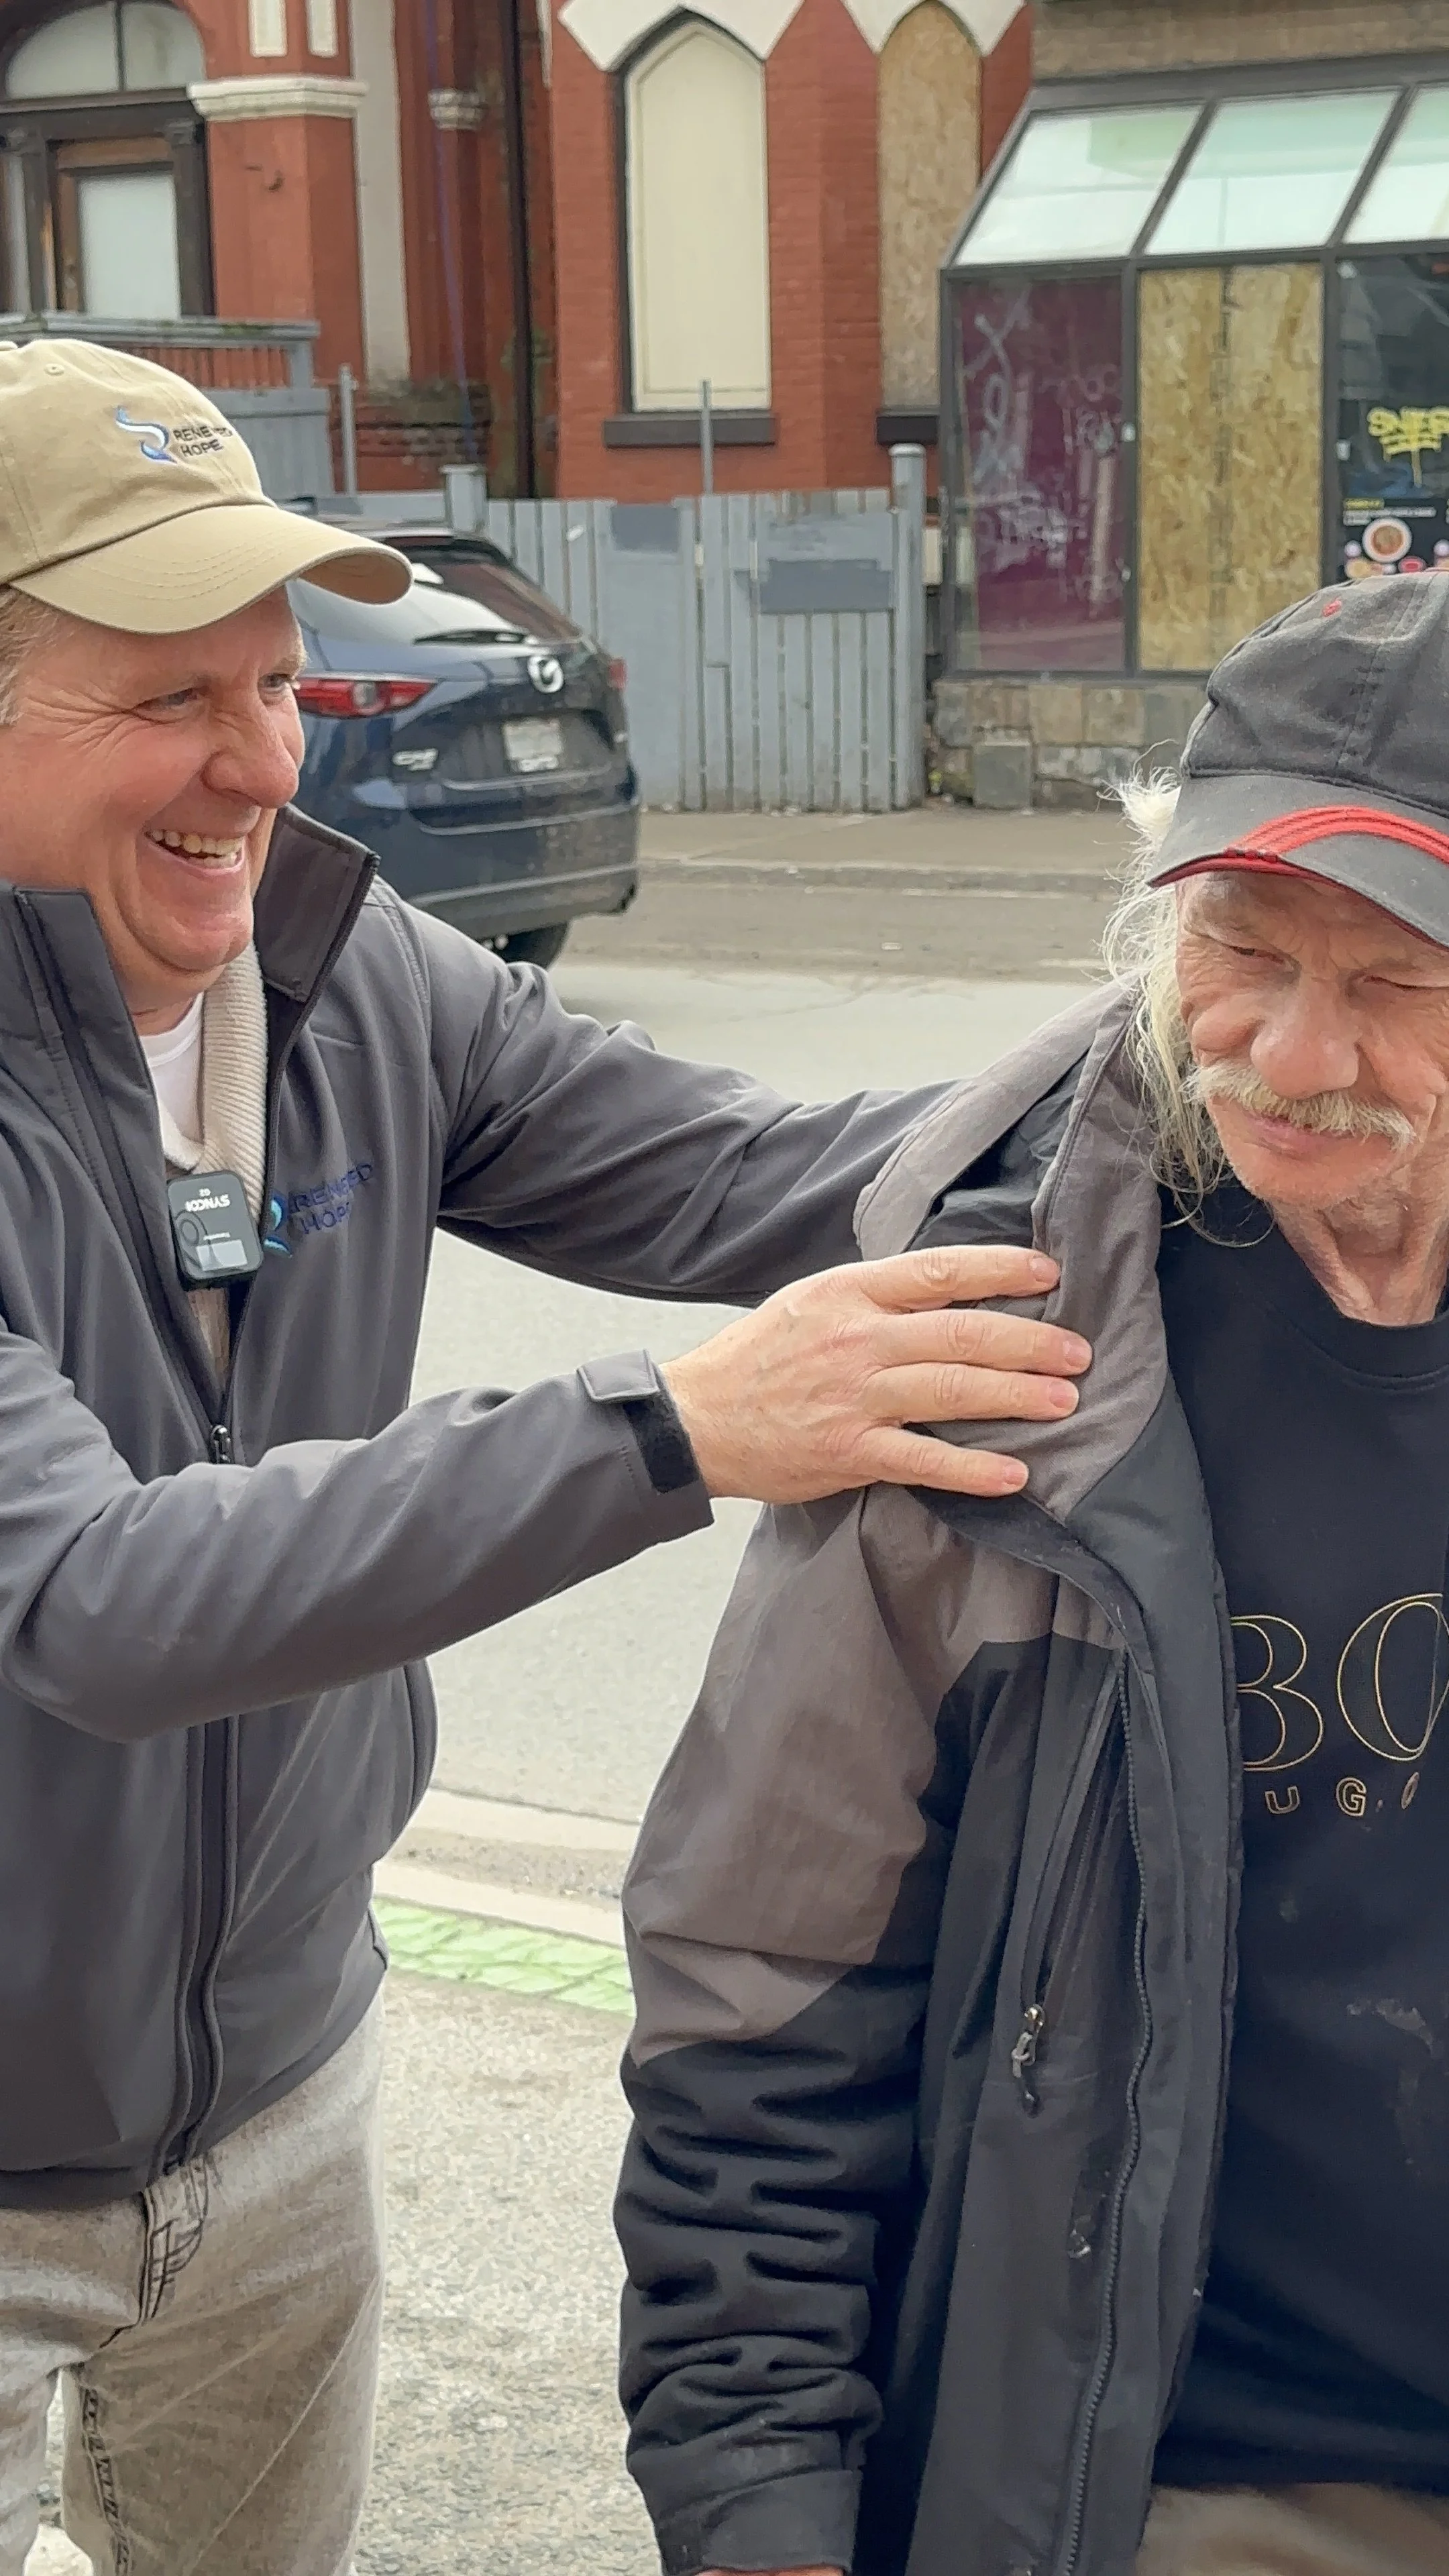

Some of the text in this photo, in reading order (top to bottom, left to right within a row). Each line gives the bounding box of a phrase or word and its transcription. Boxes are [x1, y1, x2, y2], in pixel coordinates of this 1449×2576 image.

[172, 425, 233, 441] RENEED
[180, 439, 224, 456] HOPE
[300, 1201, 350, 1235] HOP
